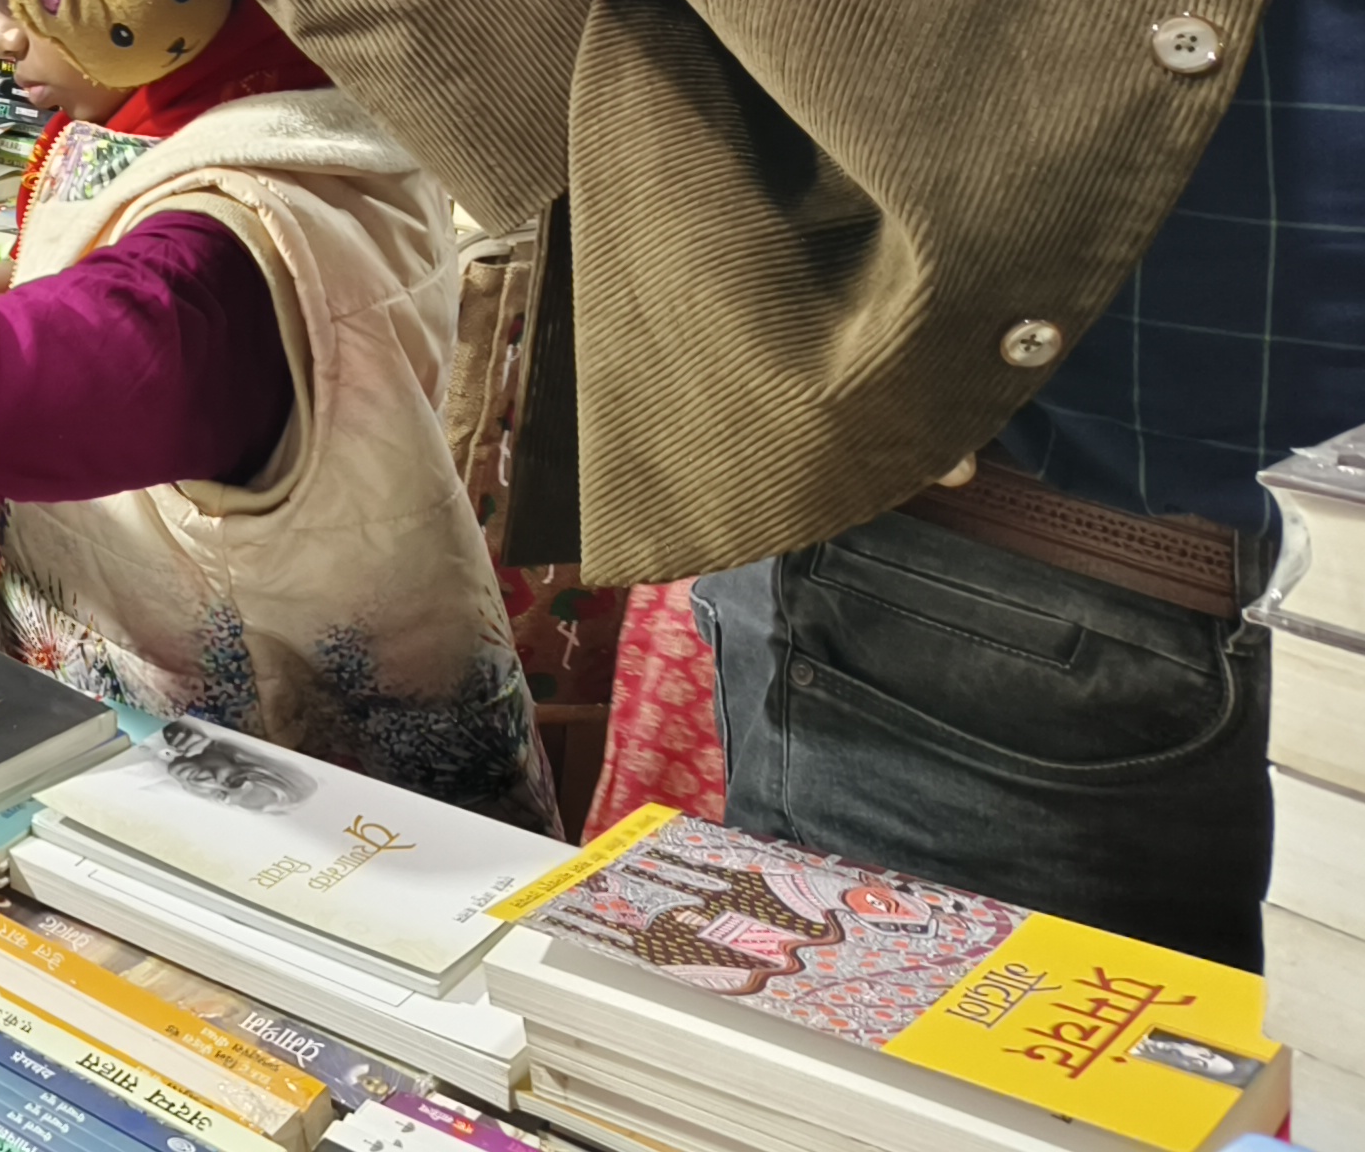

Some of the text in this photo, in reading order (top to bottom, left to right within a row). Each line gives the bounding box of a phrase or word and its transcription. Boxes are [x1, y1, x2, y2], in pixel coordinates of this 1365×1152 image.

[249, 855, 312, 890] विचार
[944, 964, 1062, 1029] गोदान
[1002, 965, 1197, 1080] प्रेमचंद
[75, 1052, 213, 1133] अदम्य साहस
